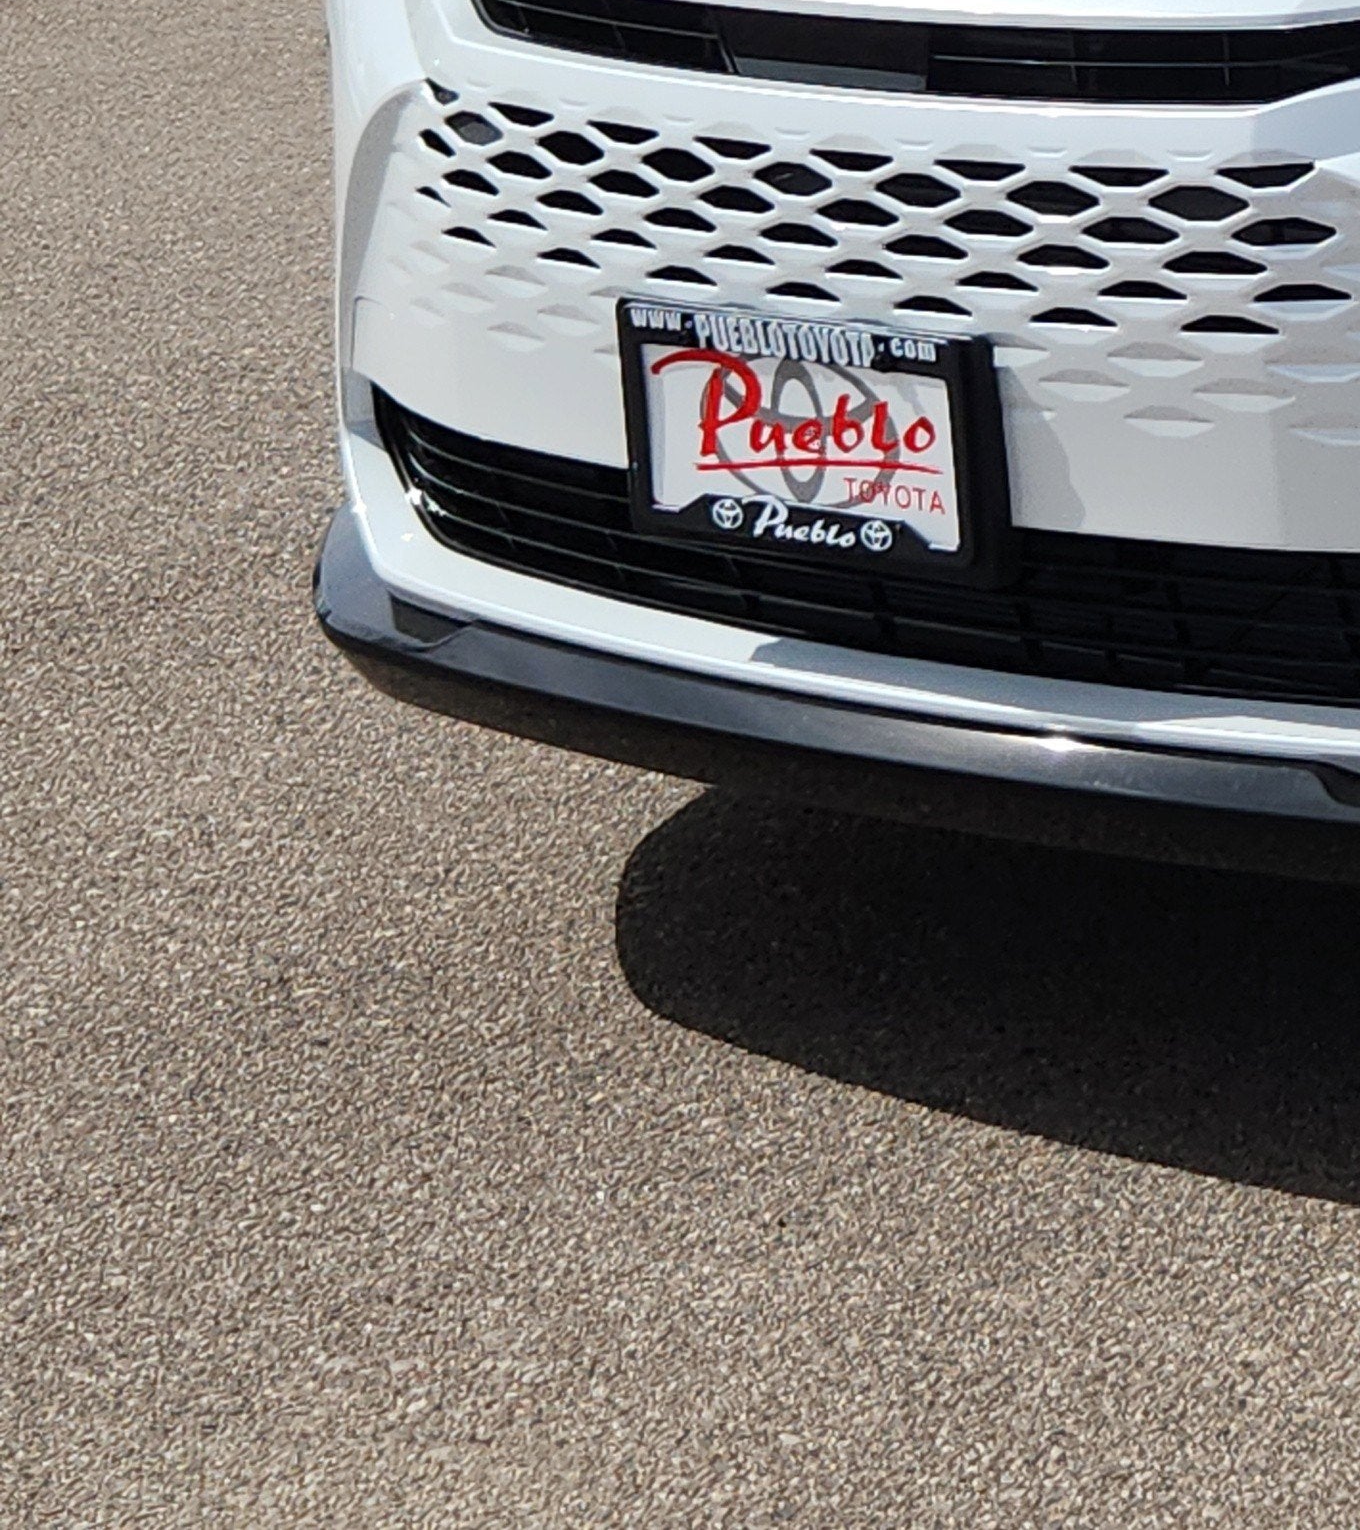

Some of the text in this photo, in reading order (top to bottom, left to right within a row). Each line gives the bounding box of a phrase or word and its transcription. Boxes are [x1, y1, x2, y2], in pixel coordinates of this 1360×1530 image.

[650, 348, 936, 457] Pueblo
[741, 494, 857, 548] Pueblo
[843, 476, 947, 515] TOYOTA
